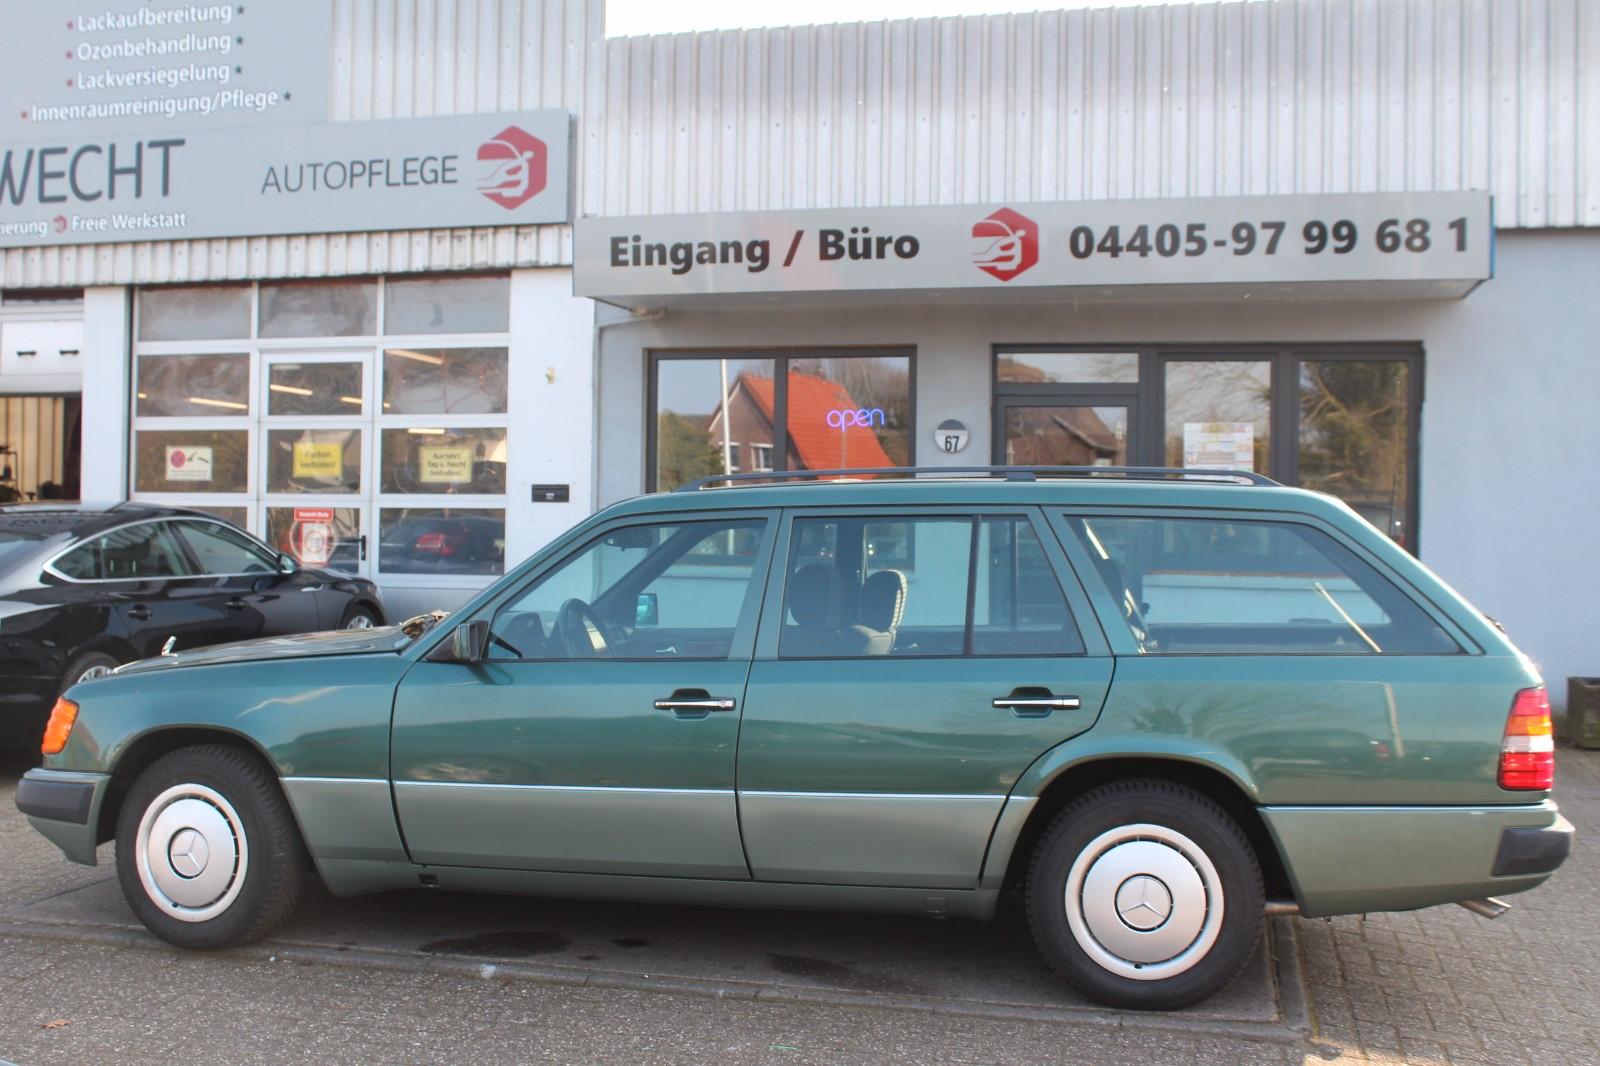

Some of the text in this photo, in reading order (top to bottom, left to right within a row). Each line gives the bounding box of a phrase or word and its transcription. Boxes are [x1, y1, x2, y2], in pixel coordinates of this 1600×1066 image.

[77, 4, 233, 33] Lackaufbereitung
[77, 33, 231, 61] Ozonbehandlung
[77, 62, 230, 91] Lackversiegelung
[31, 88, 279, 122] Innenraumreinigung/Pflege
[260, 155, 459, 194] AUTOPFLEGE
[71, 214, 108, 232] Freie
[112, 211, 187, 231] Werkstatt
[610, 227, 920, 275] Eingang / Büro
[1069, 216, 1468, 260] 04405-97 99 68 1
[826, 407, 886, 431] open
[944, 434, 961, 453] 67
